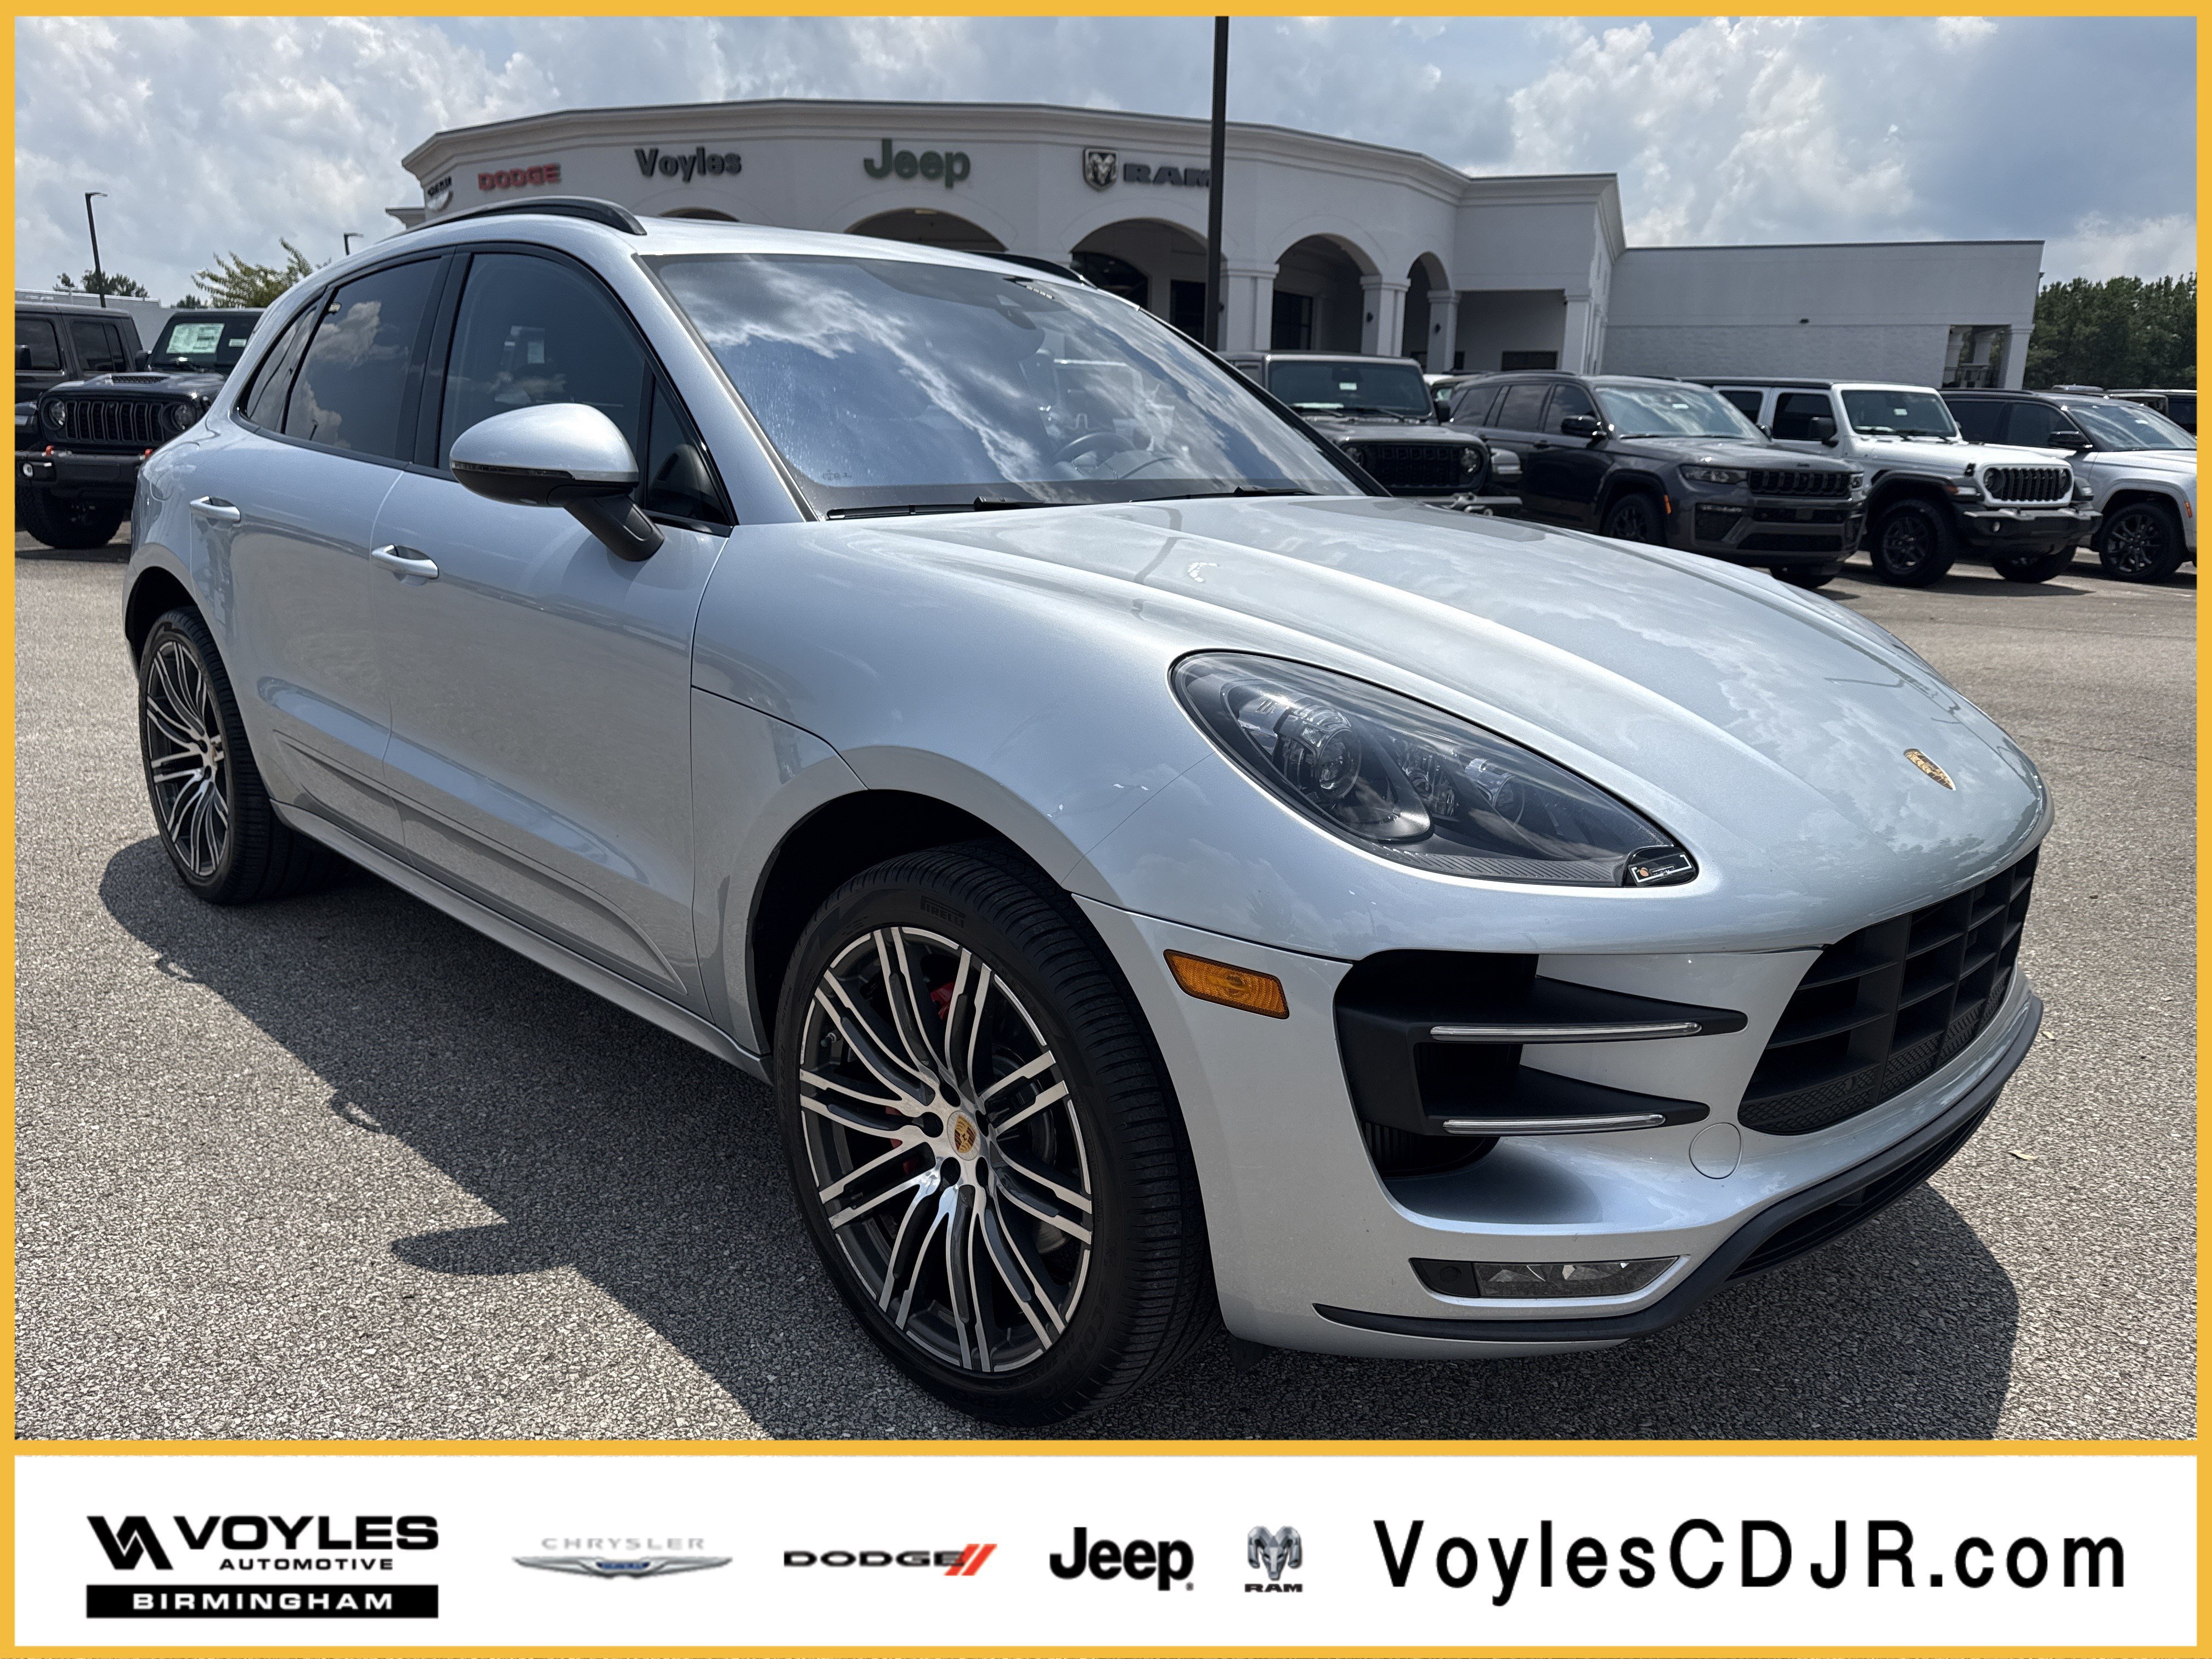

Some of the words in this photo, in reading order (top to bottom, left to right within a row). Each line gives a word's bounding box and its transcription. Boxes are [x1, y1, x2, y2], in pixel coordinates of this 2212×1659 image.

[477, 163, 561, 190] DODGE
[634, 146, 742, 183] Voyles
[864, 139, 971, 189] Jeep
[1124, 163, 1211, 187] RAM
[921, 895, 966, 928] PIRELLI
